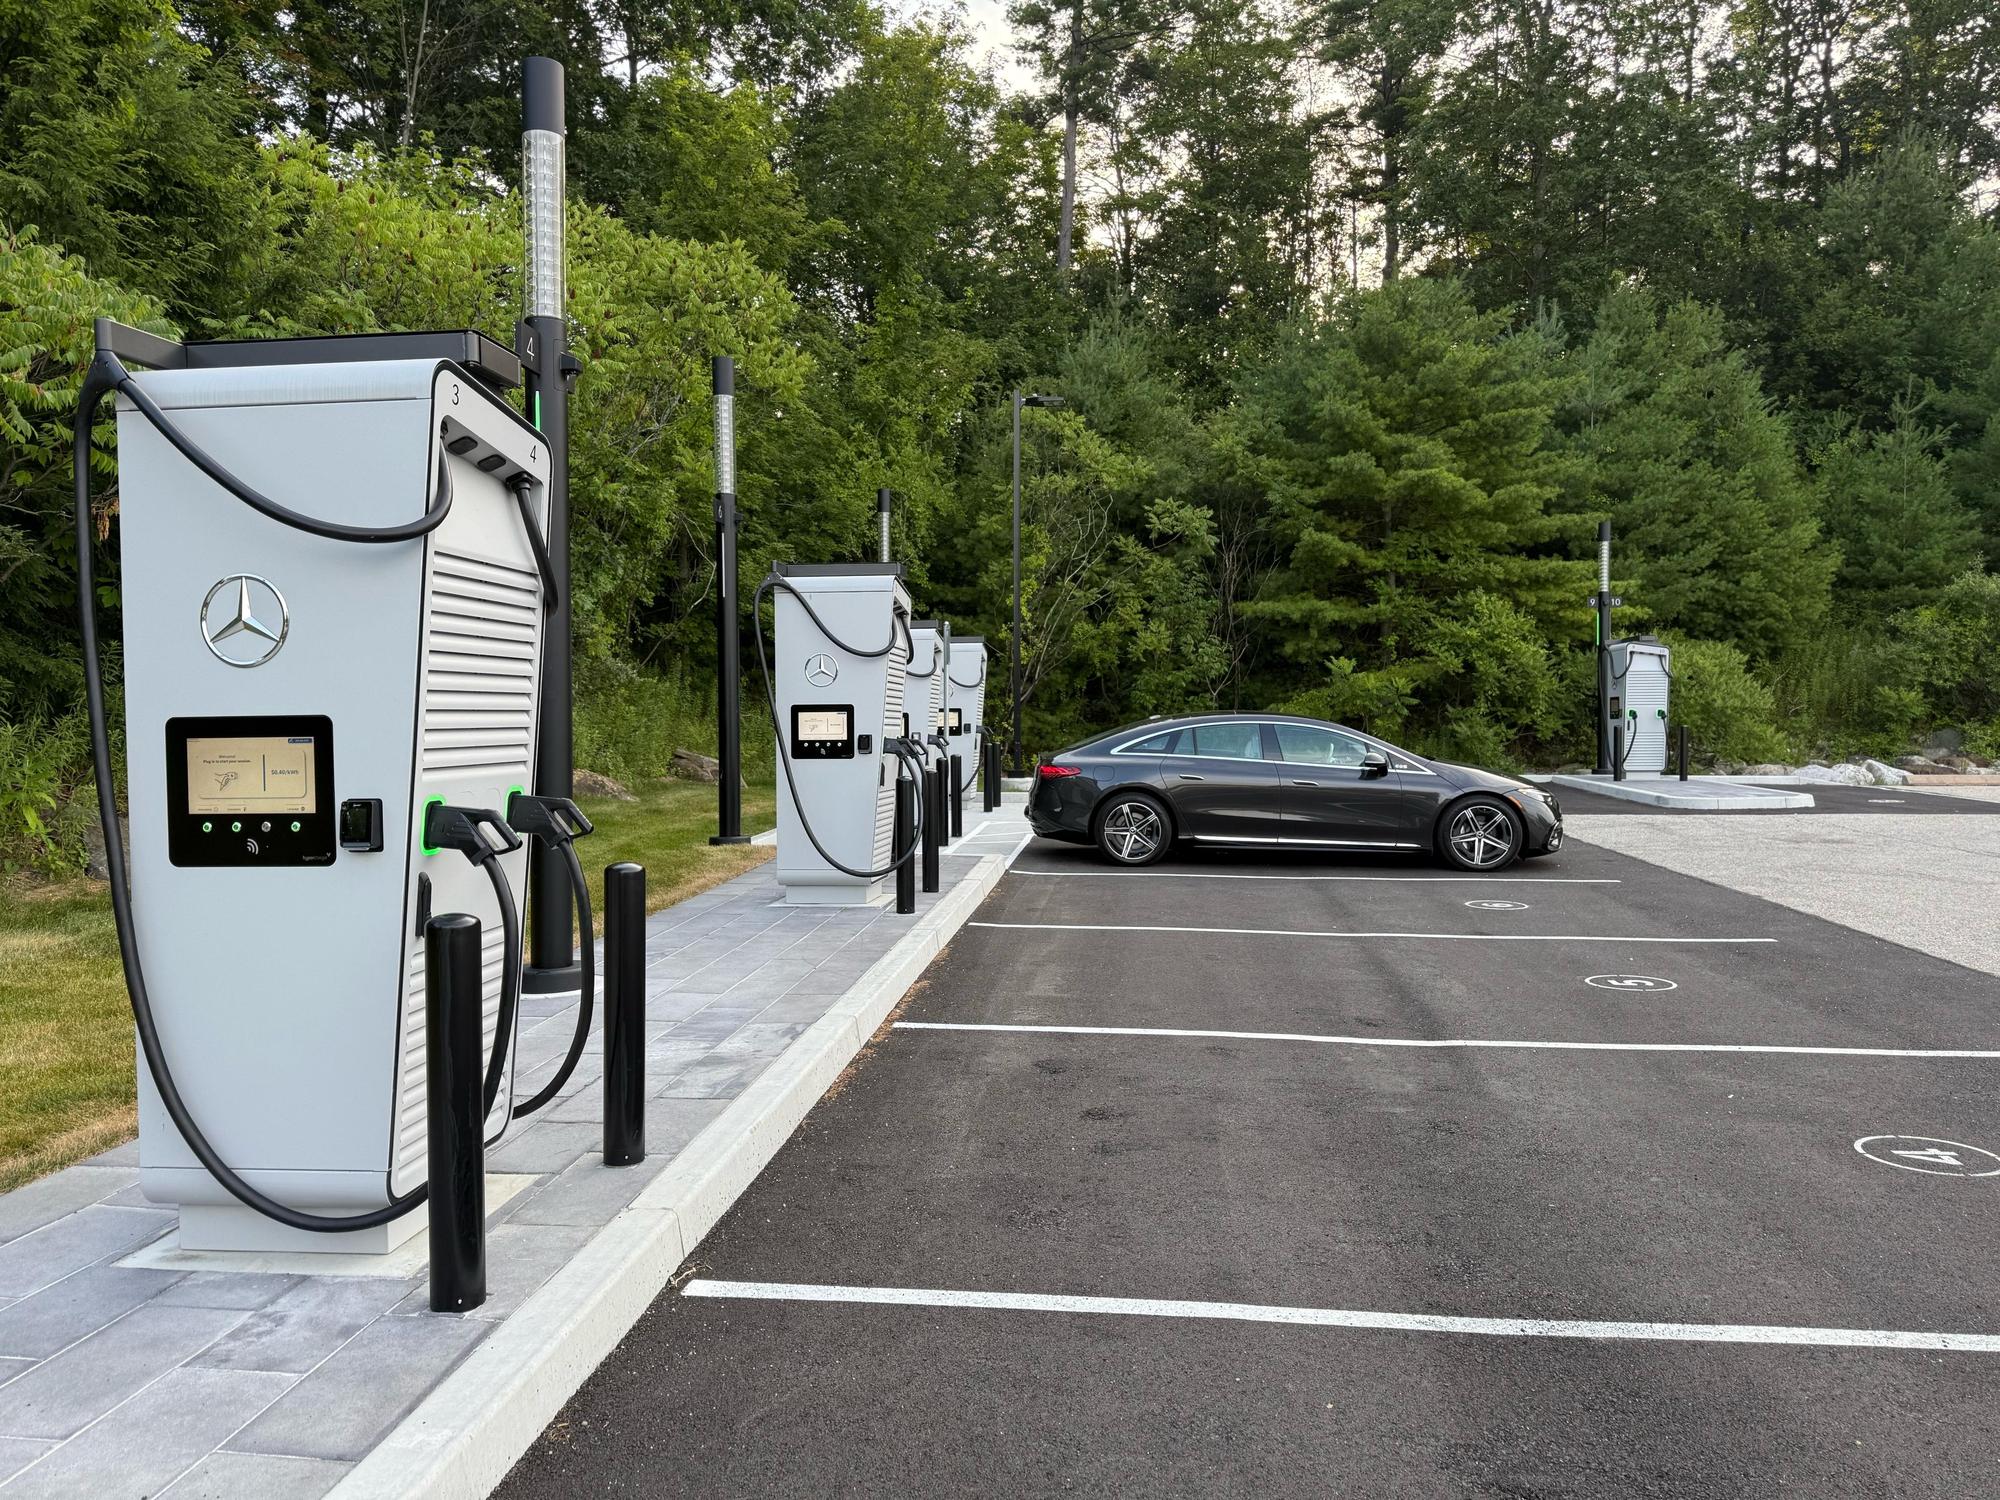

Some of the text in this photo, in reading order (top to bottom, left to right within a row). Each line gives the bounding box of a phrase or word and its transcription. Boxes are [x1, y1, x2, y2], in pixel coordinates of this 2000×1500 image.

[526, 336, 535, 362] 4
[451, 384, 460, 406] 3
[529, 445, 537, 463] 4
[1590, 598, 1596, 606] 9
[1611, 598, 1621, 606] 10
[1607, 979, 1655, 987] 5
[1889, 1148, 1965, 1166] 4
